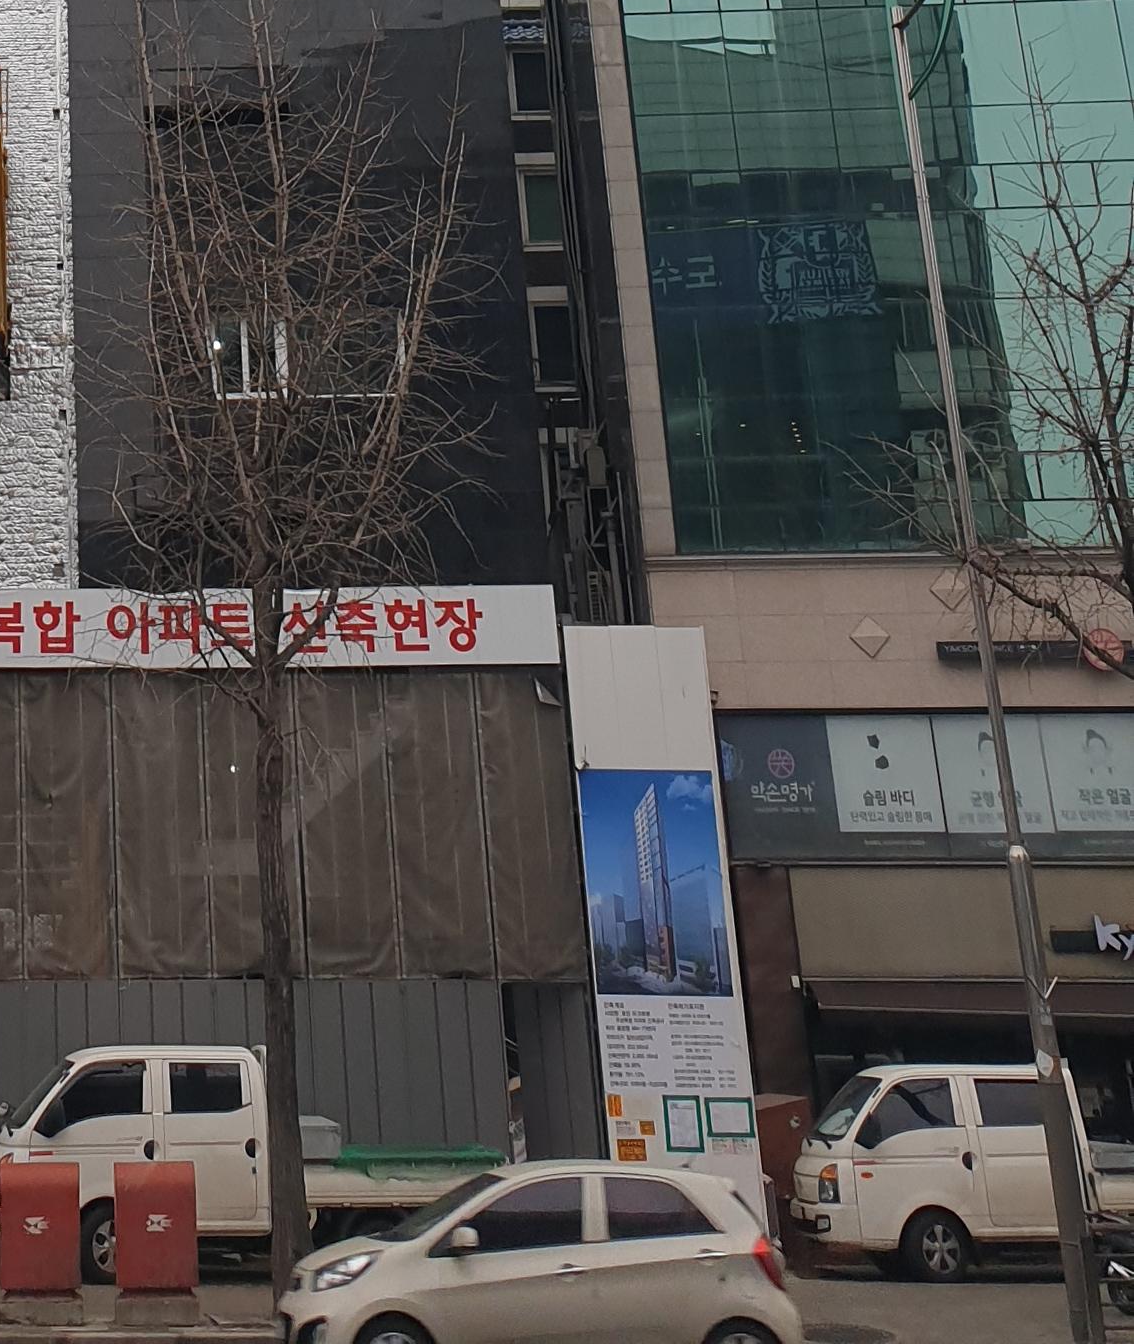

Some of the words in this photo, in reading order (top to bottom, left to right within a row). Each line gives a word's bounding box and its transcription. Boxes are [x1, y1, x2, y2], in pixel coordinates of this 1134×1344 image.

[106, 601, 255, 654] 아파트
[282, 598, 483, 653] 신축현장
[751, 781, 814, 803] 약손명가
[863, 791, 887, 807] 슬림
[891, 790, 916, 807] 바디
[1107, 788, 1131, 805] 얼굴
